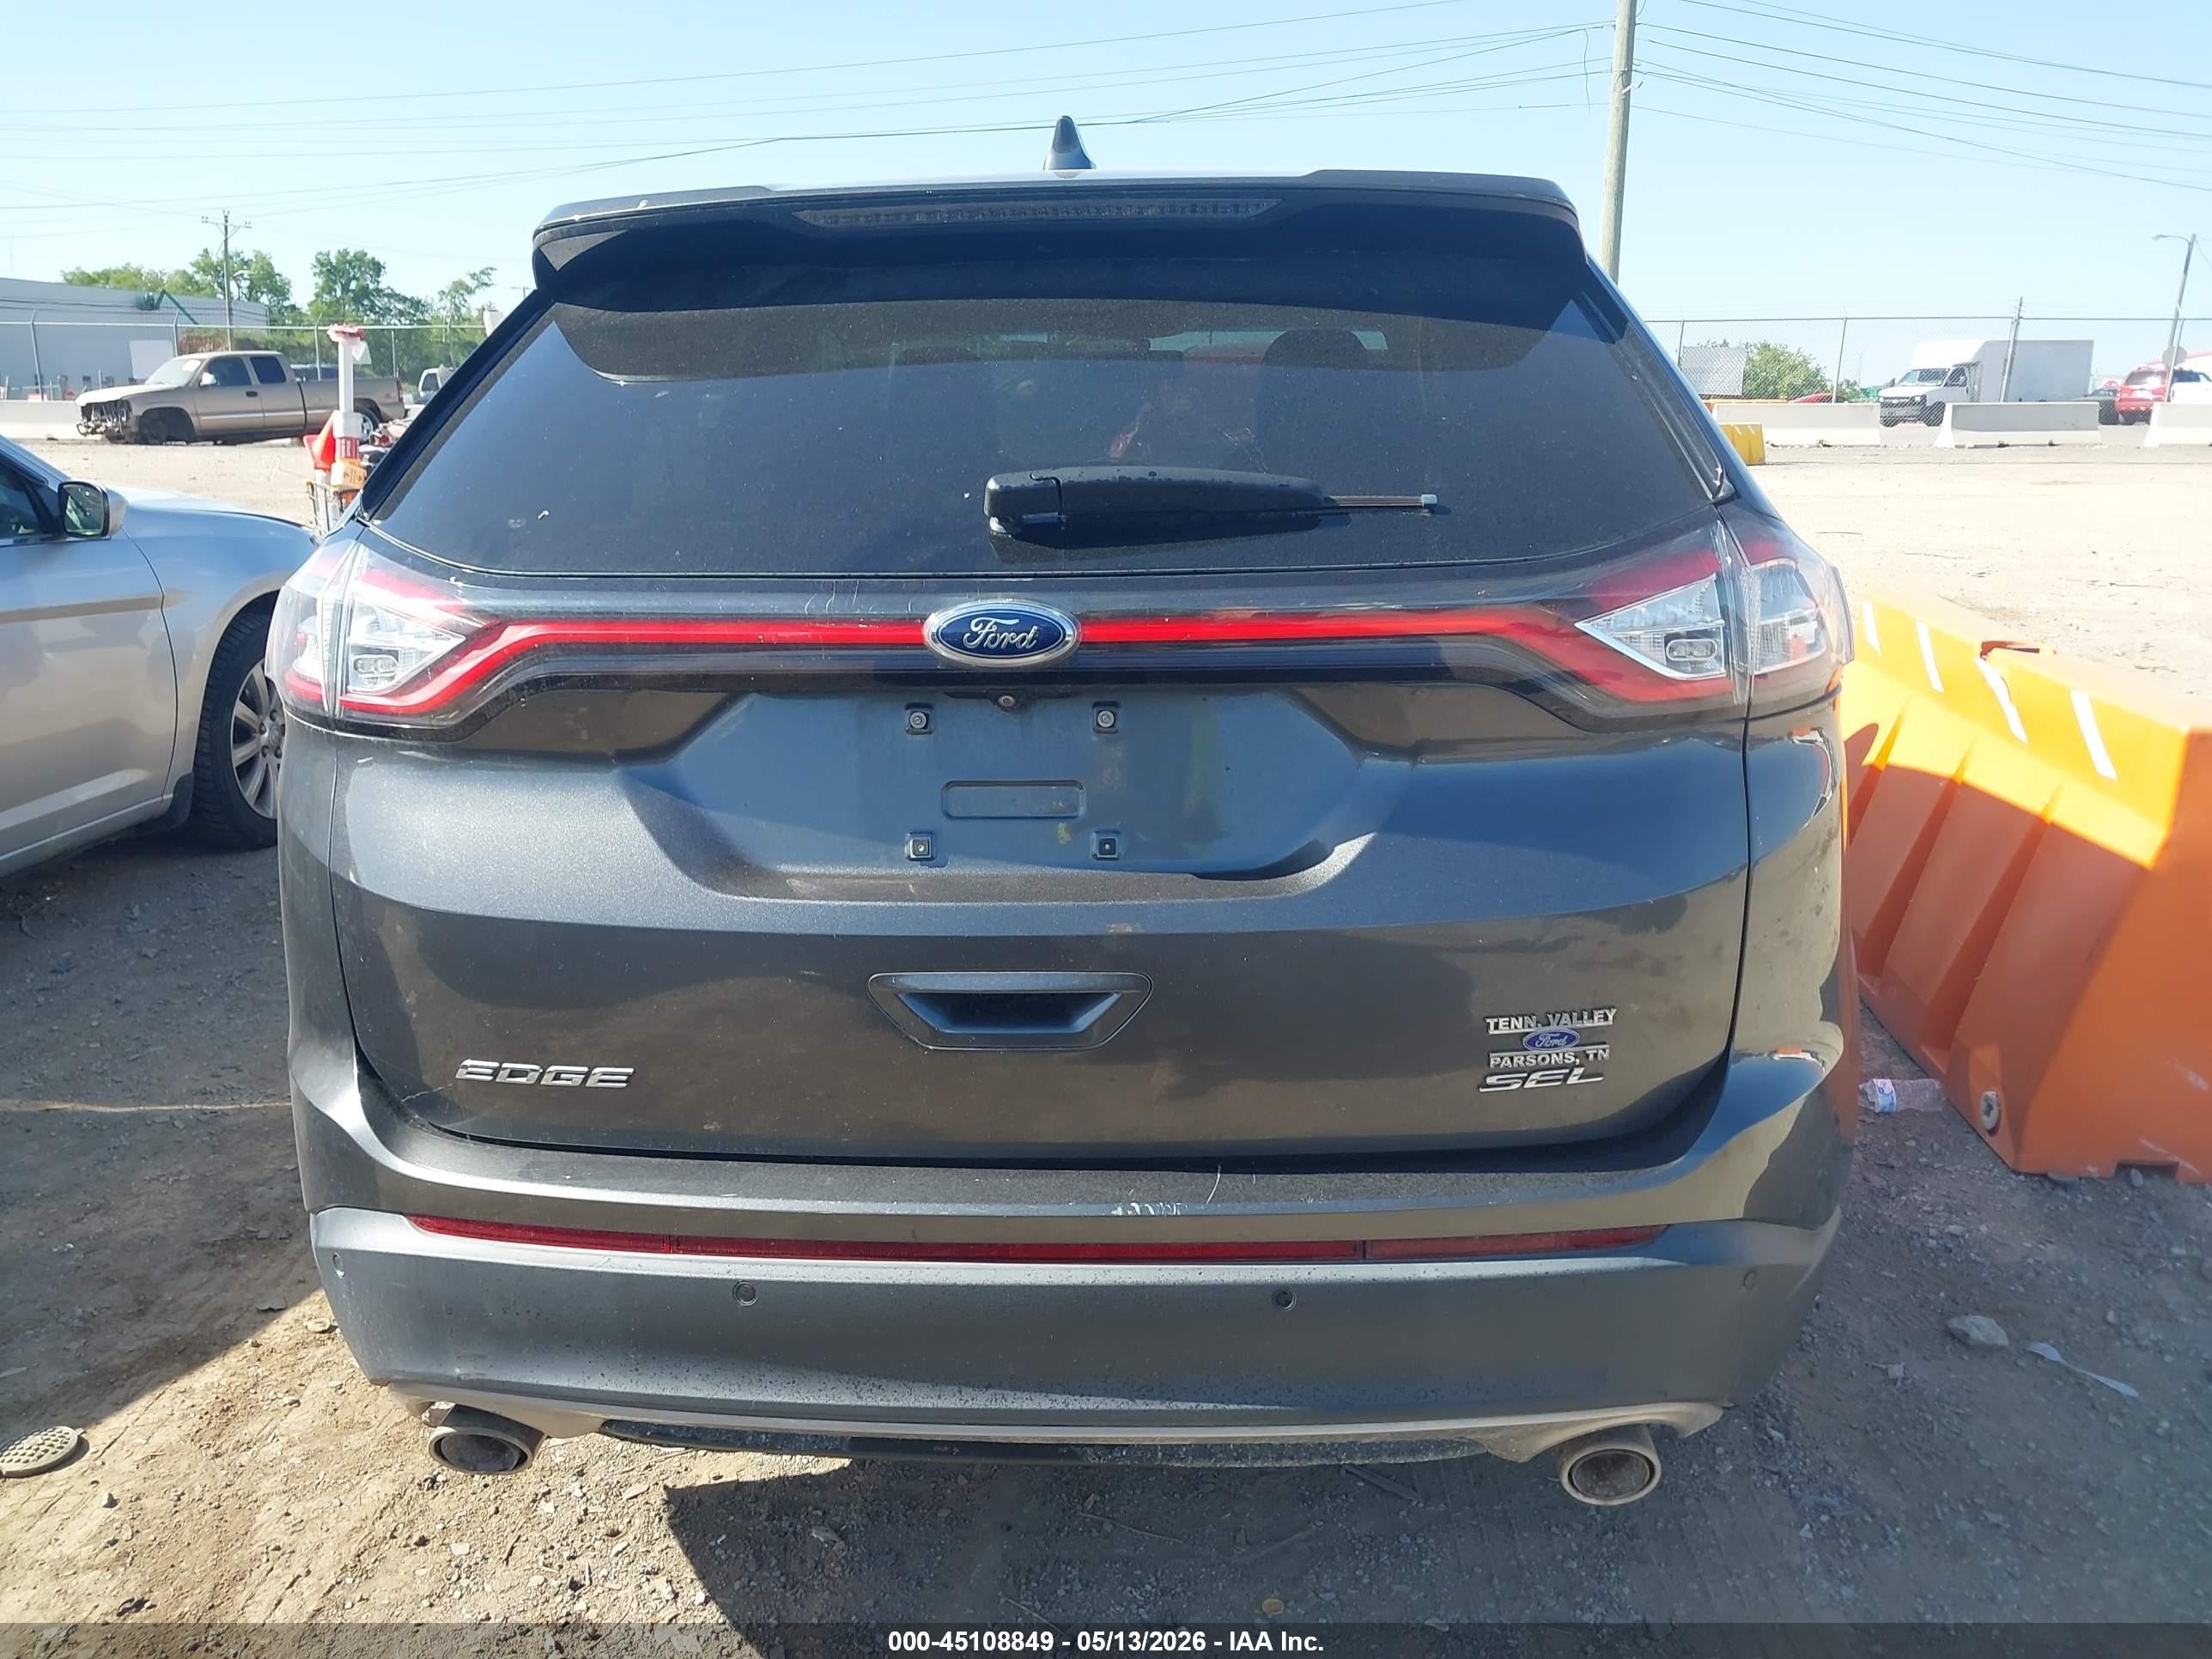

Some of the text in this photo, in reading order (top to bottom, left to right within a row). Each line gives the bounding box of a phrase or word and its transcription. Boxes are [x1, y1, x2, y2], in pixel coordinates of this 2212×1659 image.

[963, 617, 1037, 649] Ford
[1486, 1008, 1618, 1031] TENN. VALLEY
[1535, 1033, 1568, 1048] Ford
[1490, 1048, 1610, 1069] PARSONS, TN
[454, 1059, 635, 1088] EDGE
[1479, 1067, 1604, 1092] SEL
